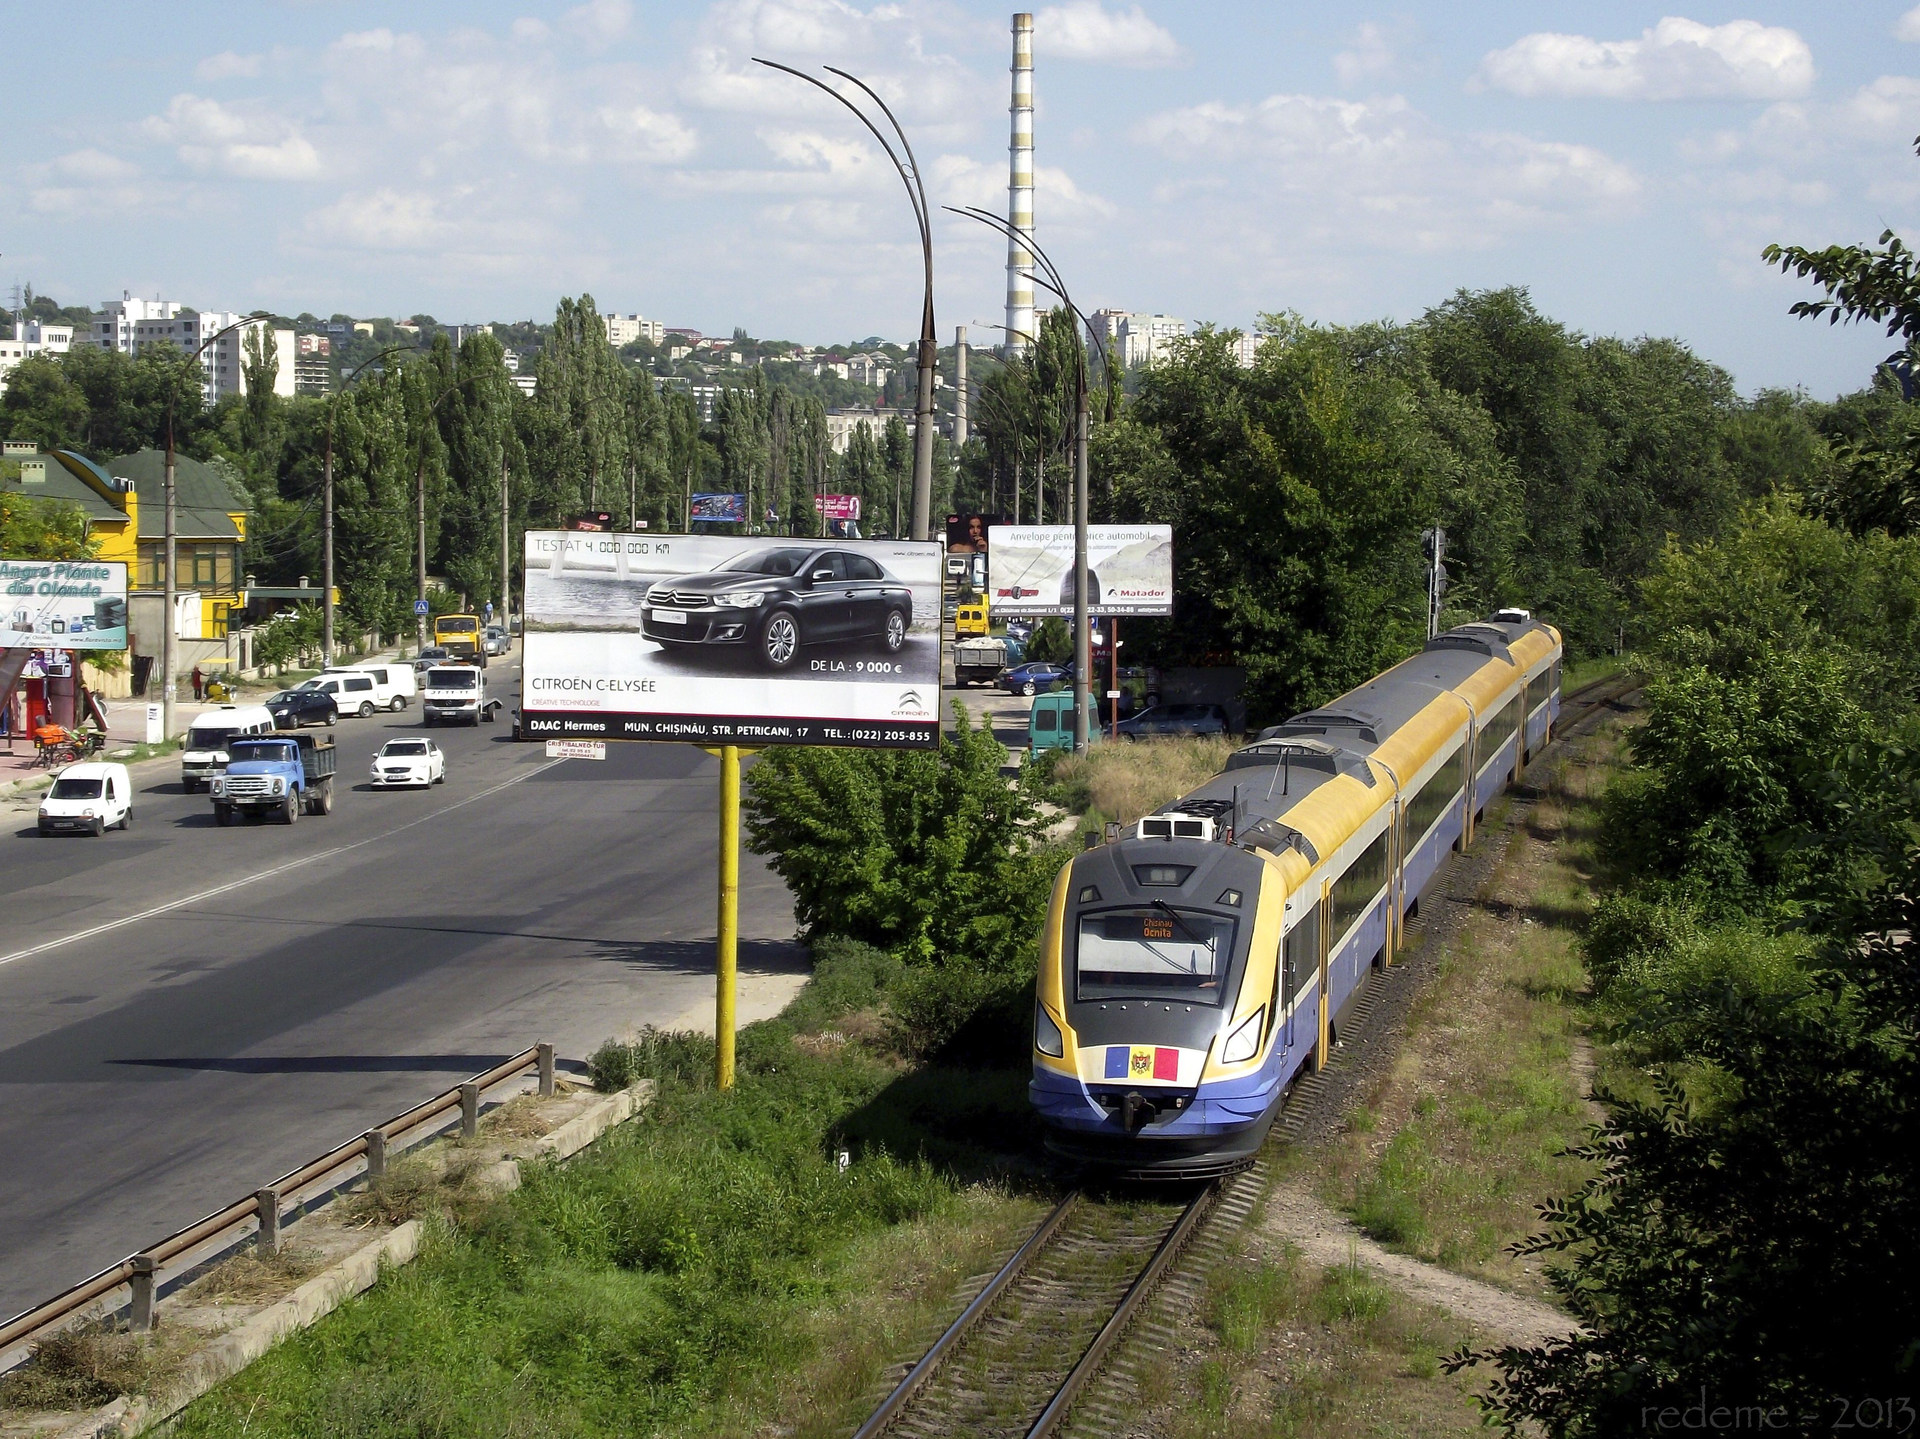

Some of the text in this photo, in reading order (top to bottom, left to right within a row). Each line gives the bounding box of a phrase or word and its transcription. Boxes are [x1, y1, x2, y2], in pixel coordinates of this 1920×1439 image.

[1010, 532, 1050, 542] Anvelope
[1107, 532, 1151, 540] automobil
[536, 540, 581, 551] TESTAT
[656, 543, 670, 554] KM
[0, 562, 110, 583] Angro Plante
[6, 580, 102, 596] din Olanda
[811, 660, 827, 671] DE
[830, 661, 845, 672] LA
[856, 661, 864, 672] 9
[867, 662, 891, 673] 000
[532, 676, 656, 692] CITROËN C-ELYSÉE
[560, 699, 600, 707] TECHNOLOGIE
[530, 721, 606, 731] DAAC Hermes
[624, 722, 809, 738] MUN. CHIȘINĂU, STR. PETRICANI, 17
[884, 731, 931, 741] 205-855
[1143, 928, 1172, 937] Ocnita
